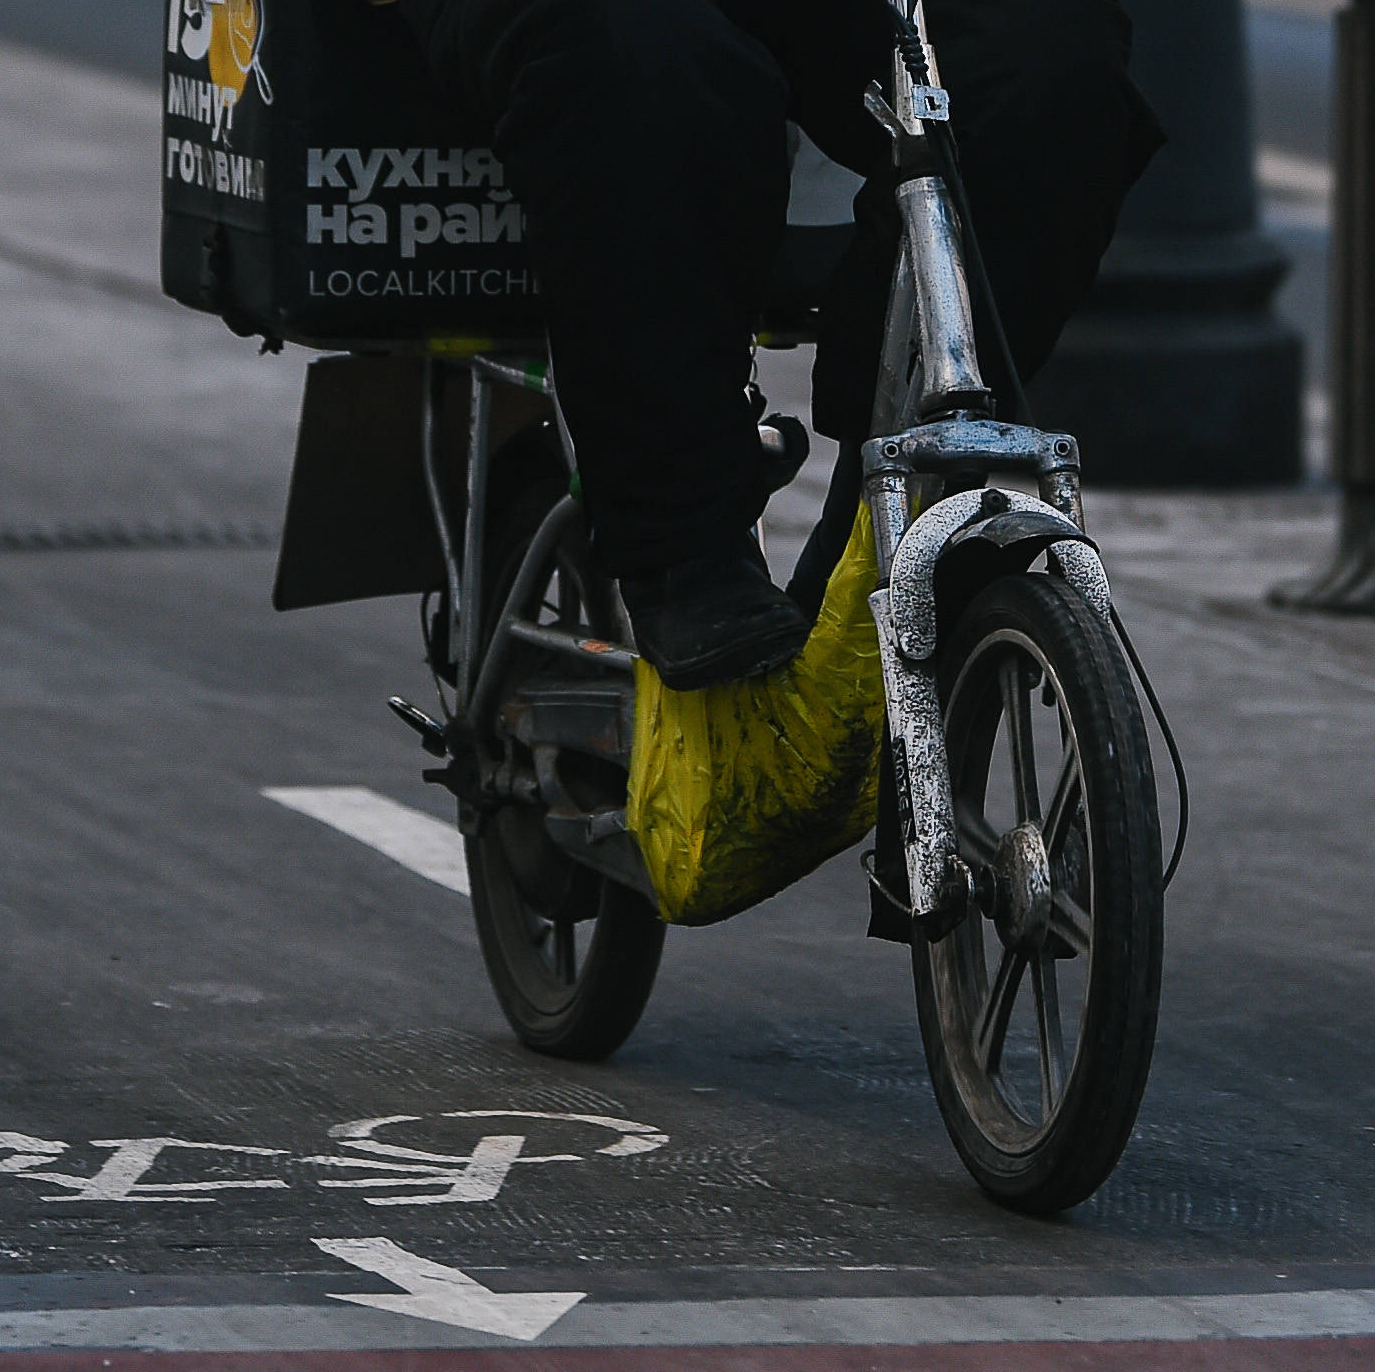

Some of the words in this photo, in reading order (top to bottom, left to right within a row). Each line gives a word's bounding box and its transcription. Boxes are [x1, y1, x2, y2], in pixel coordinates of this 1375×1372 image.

[307, 147, 504, 204] кухня
[307, 203, 388, 245] на
[400, 188, 526, 259] рай
